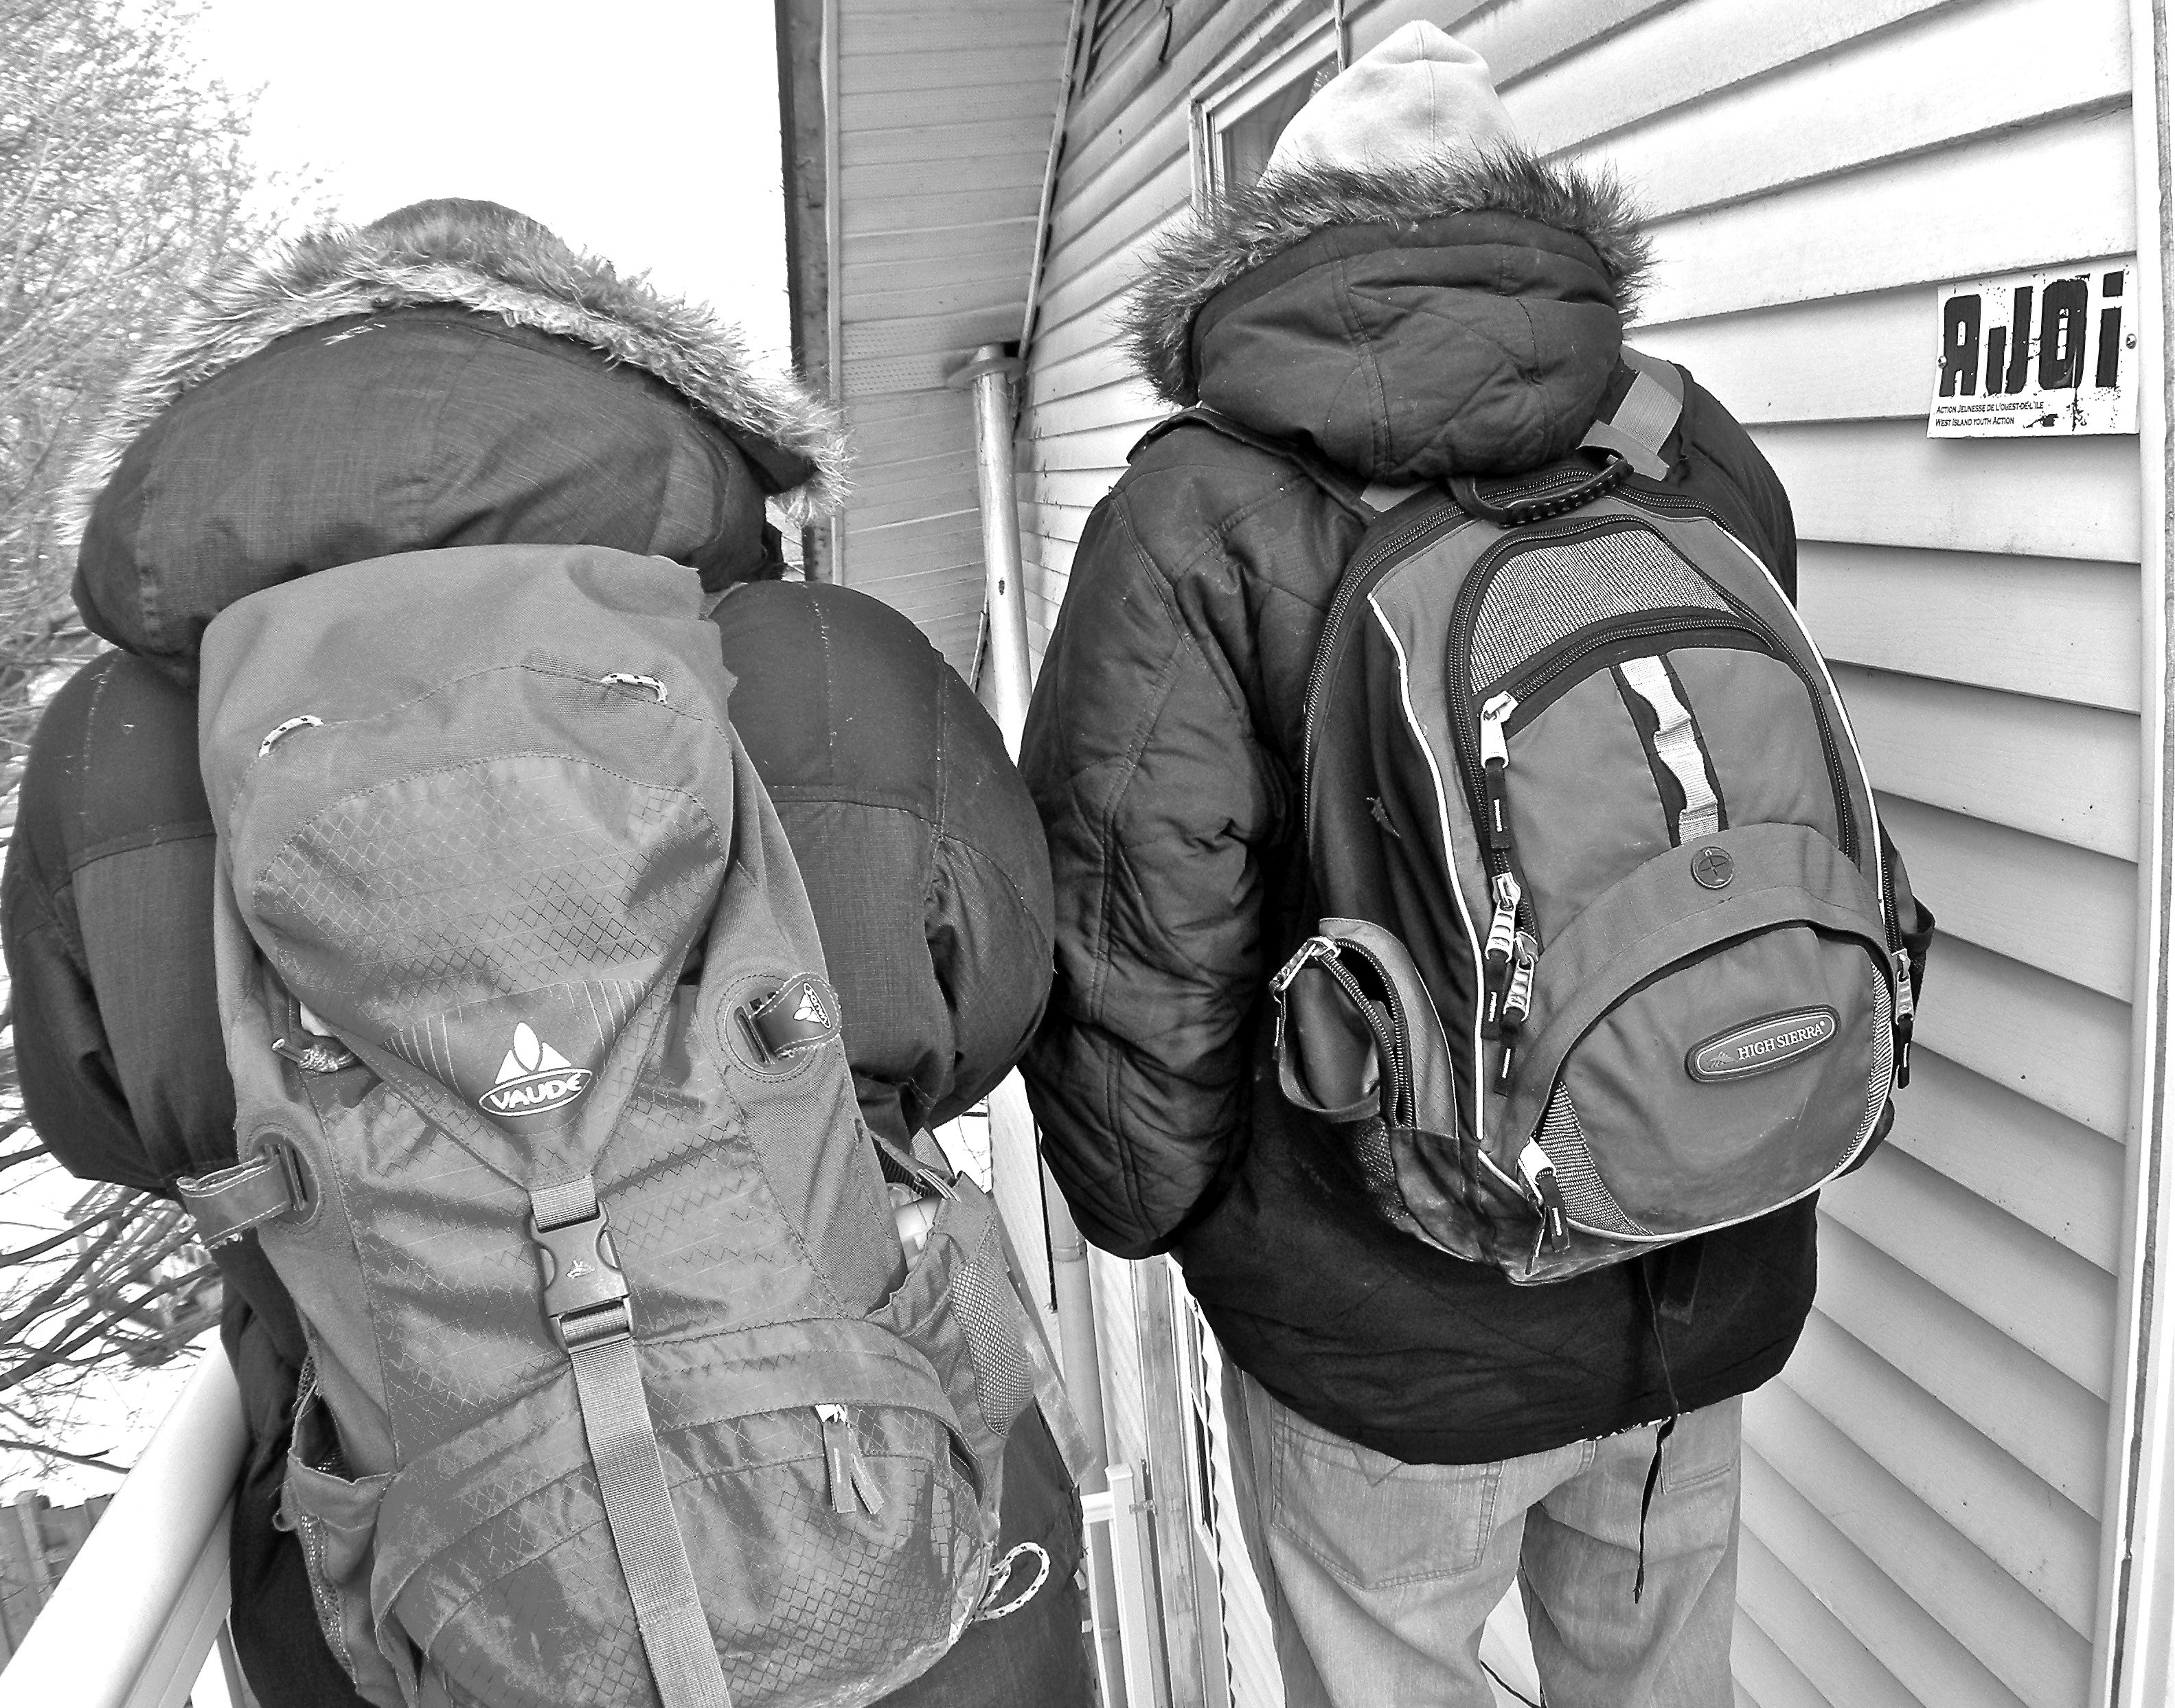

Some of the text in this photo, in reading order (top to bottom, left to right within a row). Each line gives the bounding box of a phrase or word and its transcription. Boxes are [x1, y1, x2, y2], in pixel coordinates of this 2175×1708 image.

[1935, 417, 2014, 426] WEST ISLAND YOUTH ACTION
[1737, 1038, 1775, 1060] HIGH
[489, 1073, 582, 1111] VAUDE
